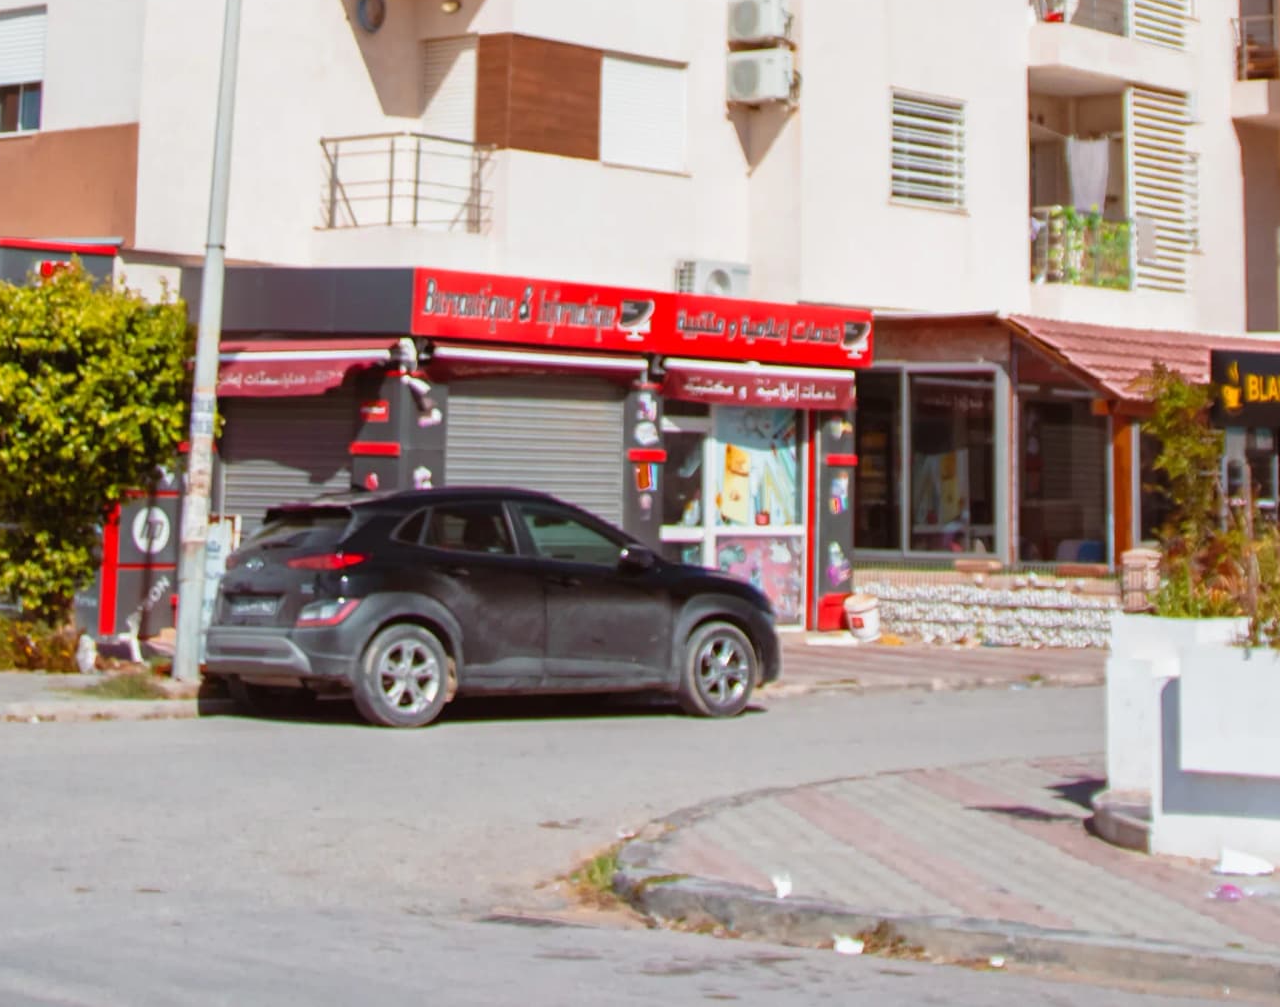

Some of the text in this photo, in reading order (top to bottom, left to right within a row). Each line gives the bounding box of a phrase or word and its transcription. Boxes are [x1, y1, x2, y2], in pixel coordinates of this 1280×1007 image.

[422, 278, 619, 343] Bureautique & Informatique
[728, 319, 738, 342] و
[791, 320, 841, 344] خدمات
